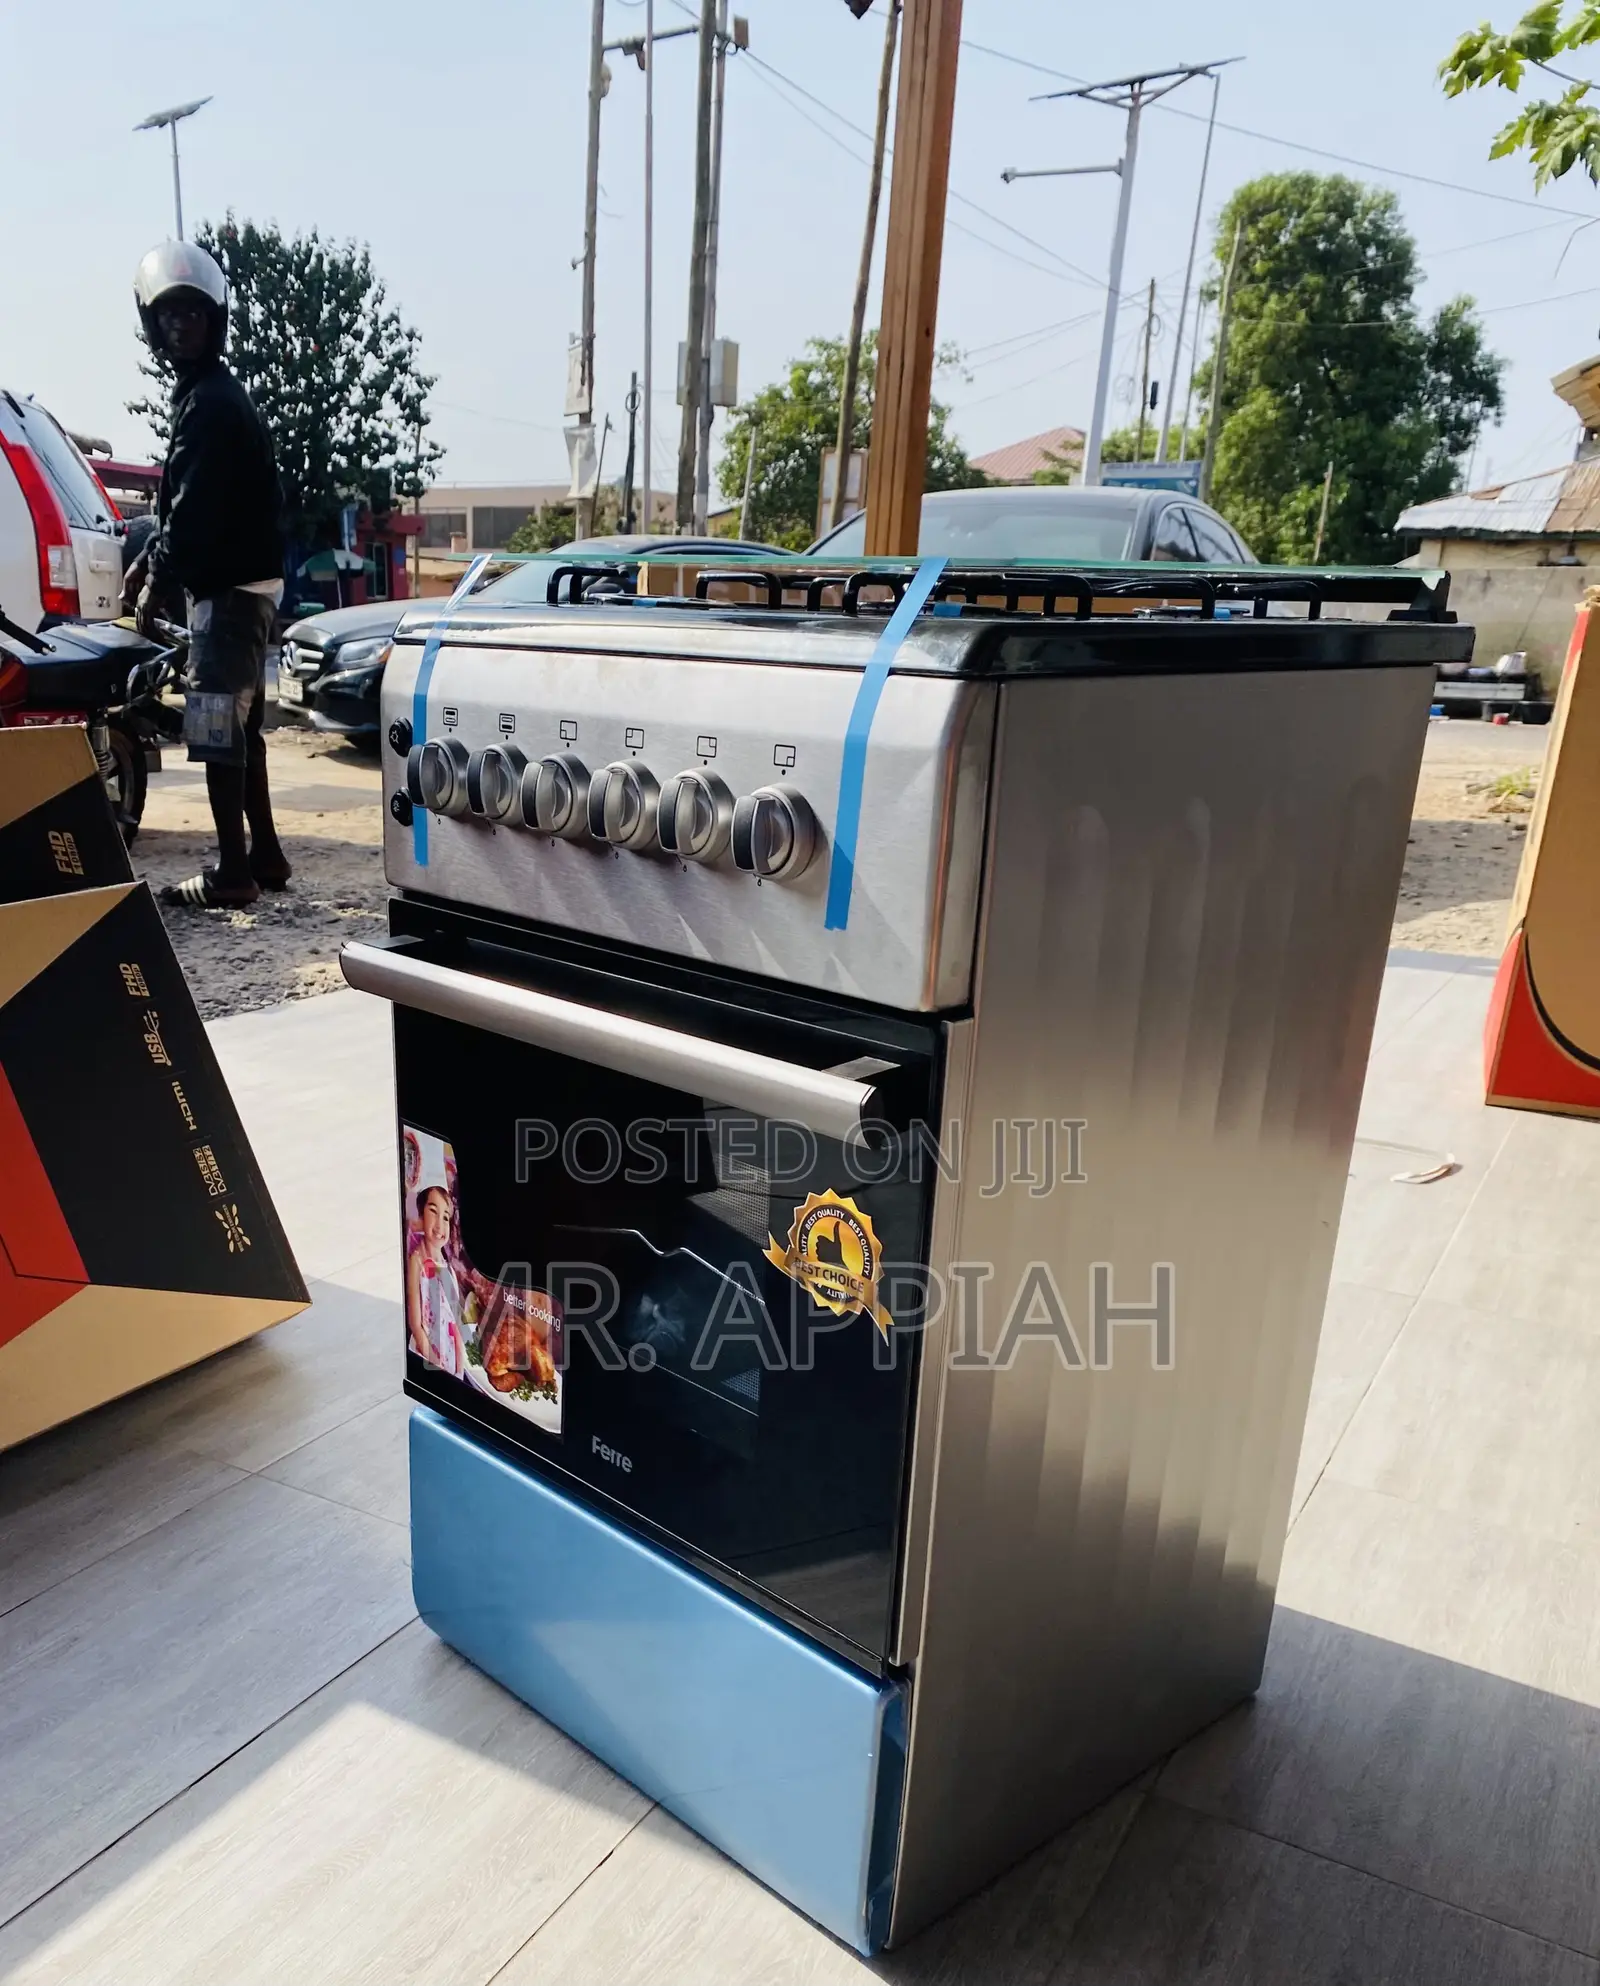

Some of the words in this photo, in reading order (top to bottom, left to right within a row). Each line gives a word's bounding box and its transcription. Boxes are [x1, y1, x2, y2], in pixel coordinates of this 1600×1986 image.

[48, 831, 73, 874] FHD
[119, 963, 142, 996] FHD
[143, 1033, 167, 1064] USB
[805, 1213, 818, 1231] BEST
[817, 1208, 845, 1220] QUALITY
[848, 1219, 863, 1241] BEST
[860, 1238, 871, 1276] QUALITY
[794, 1256, 822, 1279] BEST
[822, 1268, 865, 1293] CHOICE
[503, 1288, 526, 1311] better
[528, 1304, 561, 1332] cooking
[592, 1435, 633, 1473] Ferre
